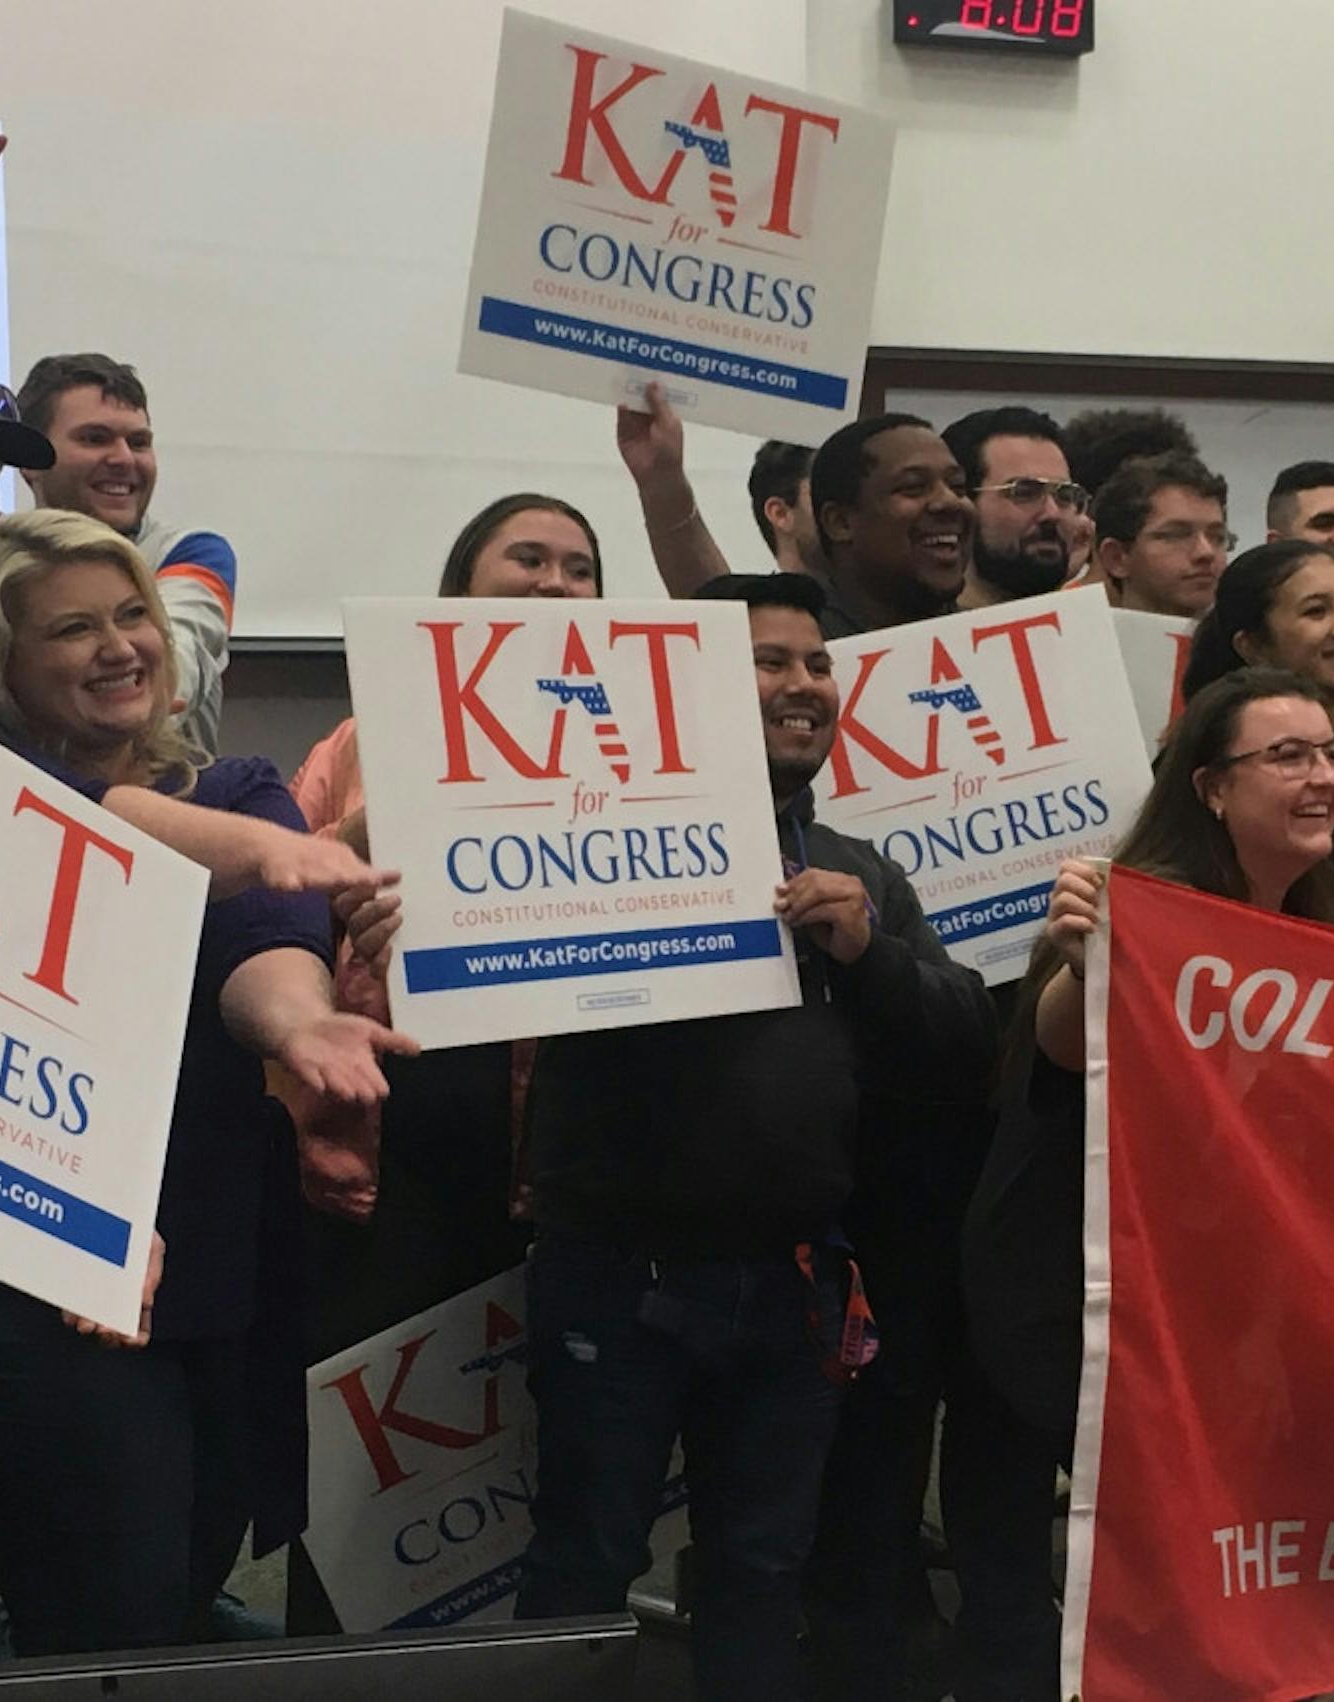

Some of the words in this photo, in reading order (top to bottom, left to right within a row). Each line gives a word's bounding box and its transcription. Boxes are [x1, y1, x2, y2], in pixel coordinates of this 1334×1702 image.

[551, 44, 840, 239] KAT
[664, 212, 708, 245] for
[539, 223, 816, 329] CONGRESS
[533, 278, 679, 326] CONSTITUTIONAL
[684, 312, 810, 355] CONSERVATIVE
[534, 317, 798, 391] www.KatForCongress.com
[416, 619, 701, 785] KAT
[828, 611, 1067, 800] KAT
[568, 781, 609, 823] for
[951, 771, 987, 809] for
[446, 822, 730, 894] CONGRESS
[875, 779, 1109, 877] ONGRESS
[452, 899, 609, 928] CONSTITUTIONAL
[615, 890, 736, 915] CONSERVATIVE
[917, 869, 997, 900] TUTIONAL
[928, 892, 1051, 935] KatForCongr
[466, 931, 736, 975] www.KatForCongress.com
[320, 1301, 527, 1497] KA
[1212, 1519, 1305, 1599] THE
